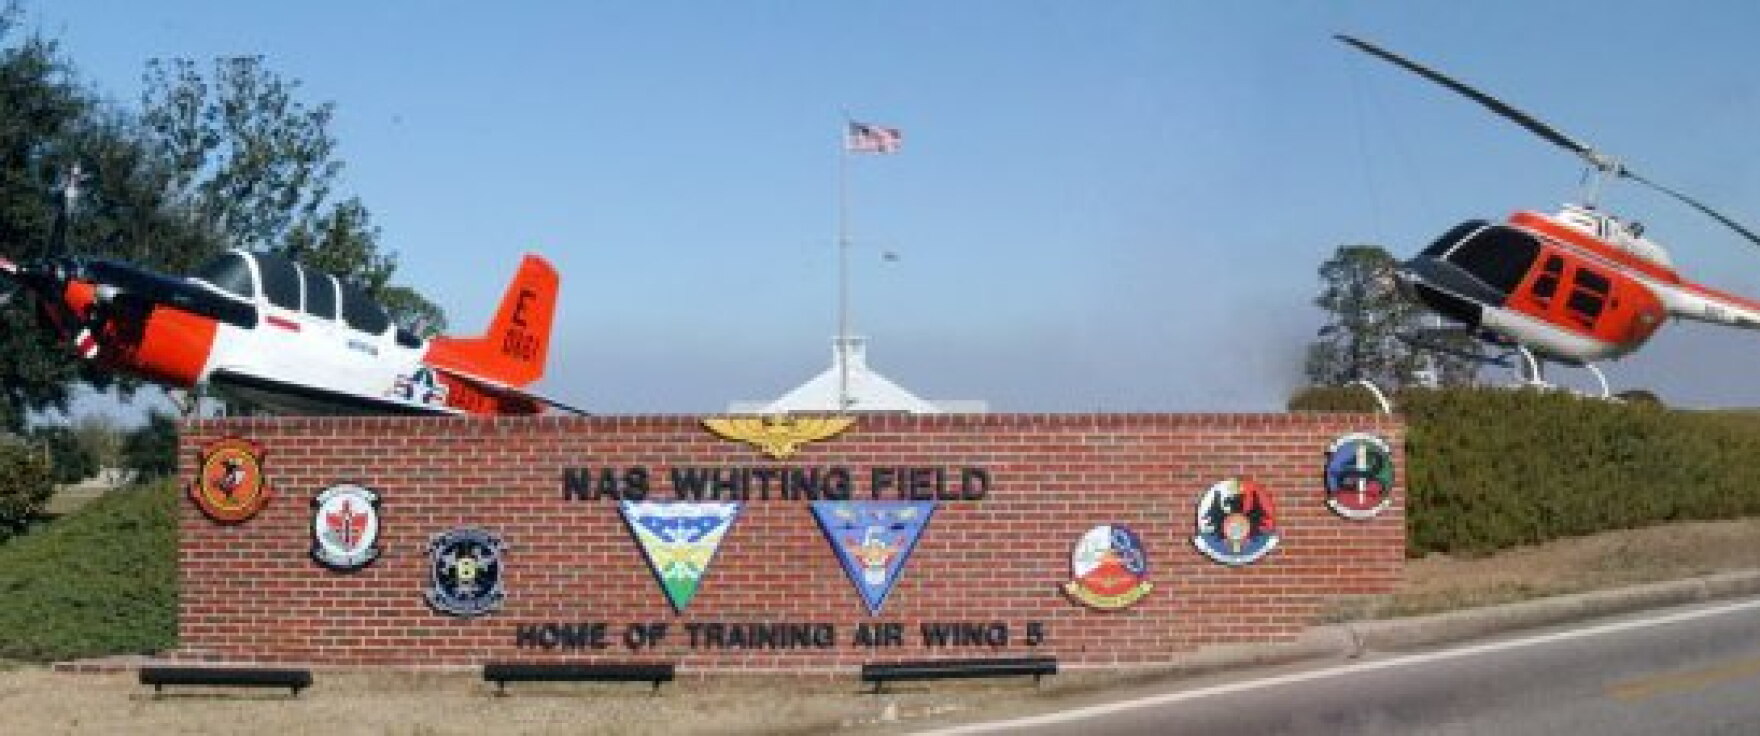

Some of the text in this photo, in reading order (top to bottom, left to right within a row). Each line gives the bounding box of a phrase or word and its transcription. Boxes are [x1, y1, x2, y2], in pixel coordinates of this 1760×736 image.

[512, 289, 537, 326] E
[564, 467, 988, 501] NAS WHITING FIELD
[516, 622, 1043, 651] HOME OF TRAINING AIR WING 5
